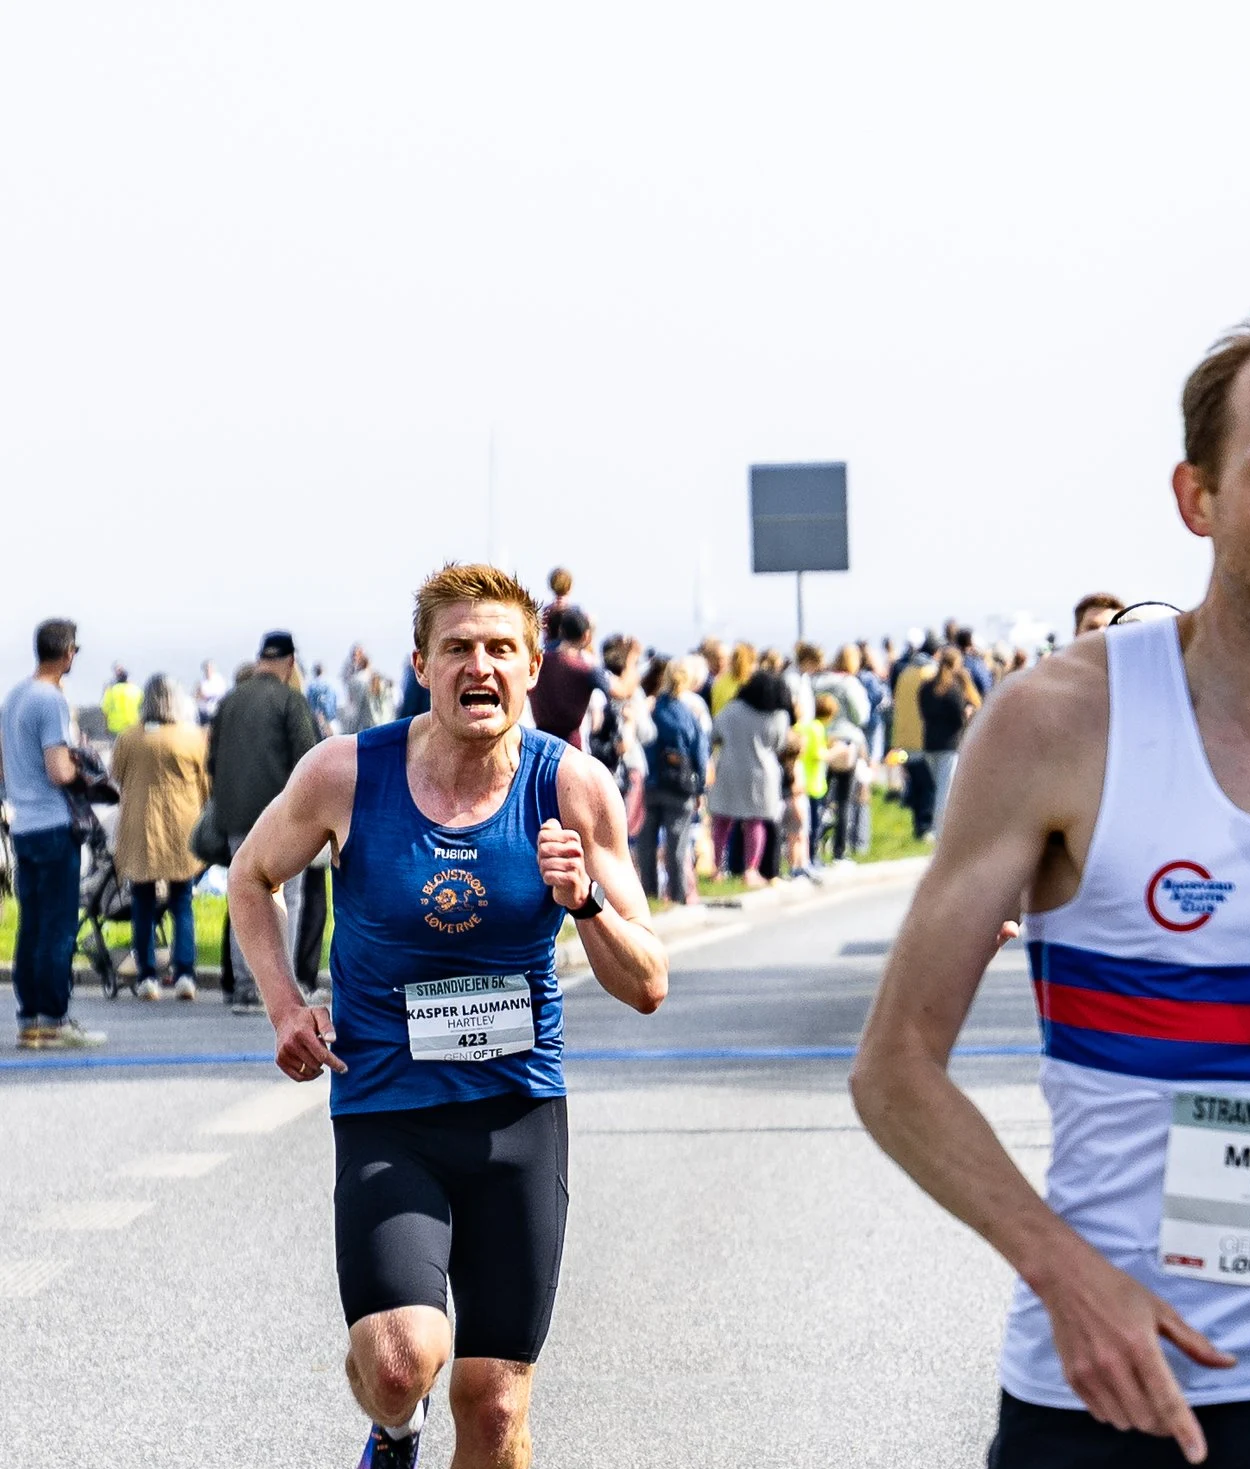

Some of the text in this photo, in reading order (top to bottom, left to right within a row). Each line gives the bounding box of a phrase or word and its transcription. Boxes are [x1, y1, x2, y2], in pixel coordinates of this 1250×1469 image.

[422, 869, 486, 897] BLOVSTRØD
[424, 912, 482, 934] LØVERNE
[416, 974, 506, 997] STRANDVEJEN 5K
[407, 997, 530, 1021] KASPER LAUMANN
[447, 1015, 495, 1029] HARTLEV
[457, 1032, 488, 1048] 423
